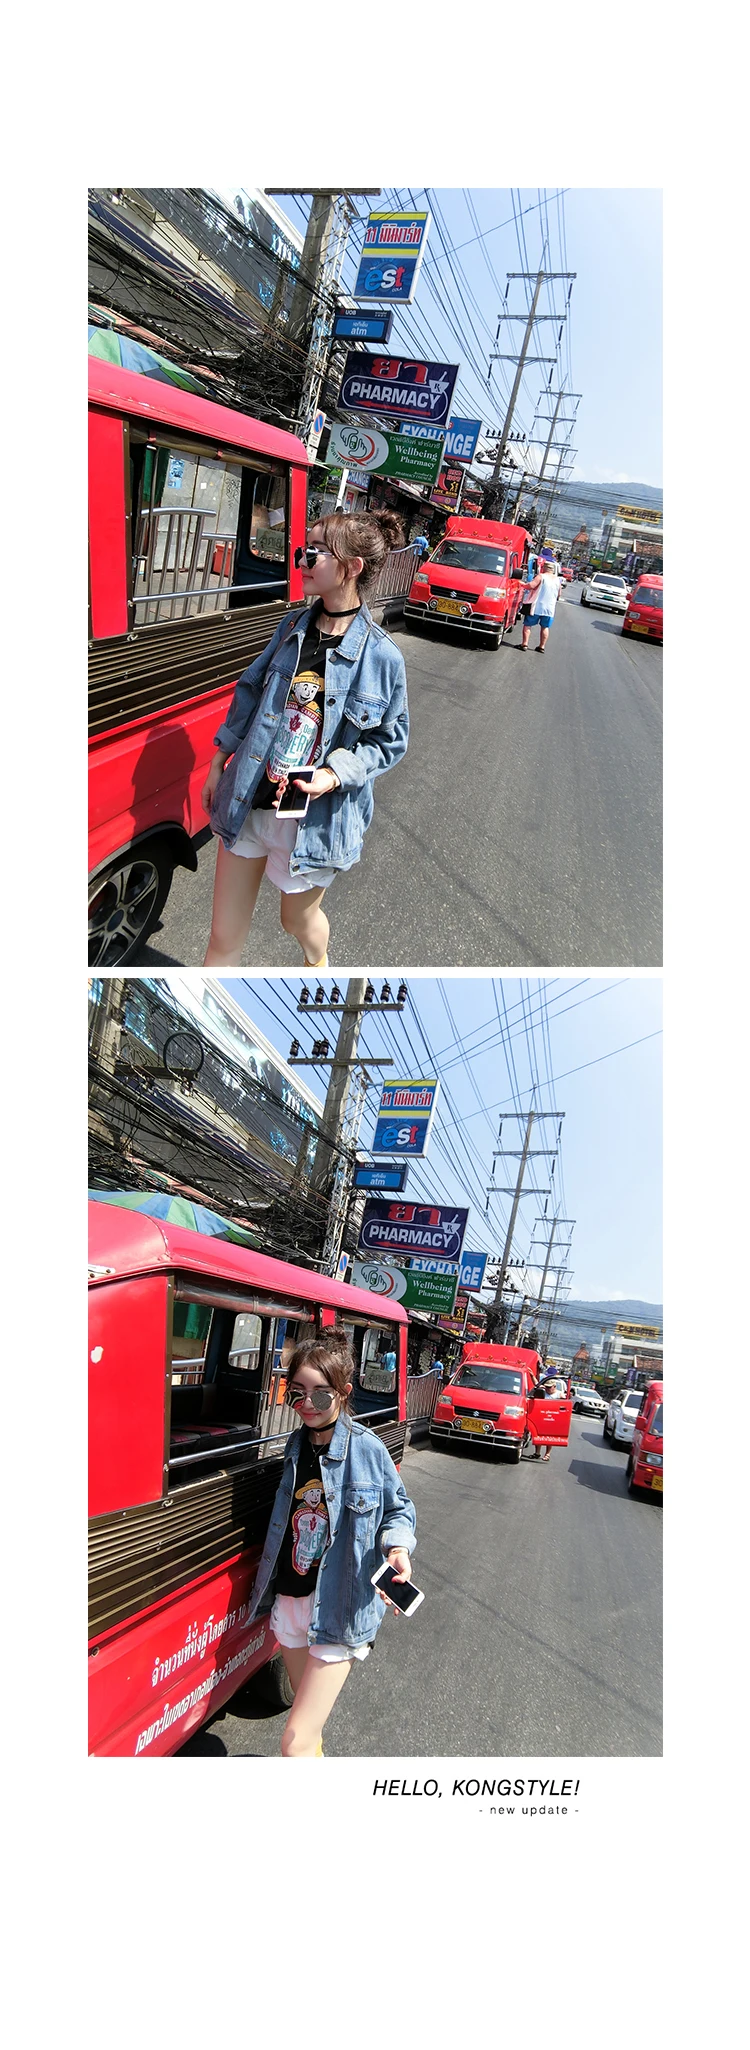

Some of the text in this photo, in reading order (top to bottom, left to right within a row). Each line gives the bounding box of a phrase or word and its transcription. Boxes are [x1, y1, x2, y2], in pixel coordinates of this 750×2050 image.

[364, 266, 405, 291] est
[350, 327, 367, 336] atm
[371, 357, 428, 385] ยา
[349, 381, 440, 410] PHARMACY
[395, 444, 438, 462] Wellbeing
[400, 455, 436, 470] Pharmacy
[381, 1126, 418, 1148] est
[387, 1203, 441, 1226] ยา
[368, 1225, 453, 1248] PHARMACY
[412, 1279, 452, 1294] Wellbeing
[418, 1289, 451, 1302] Pharmacy
